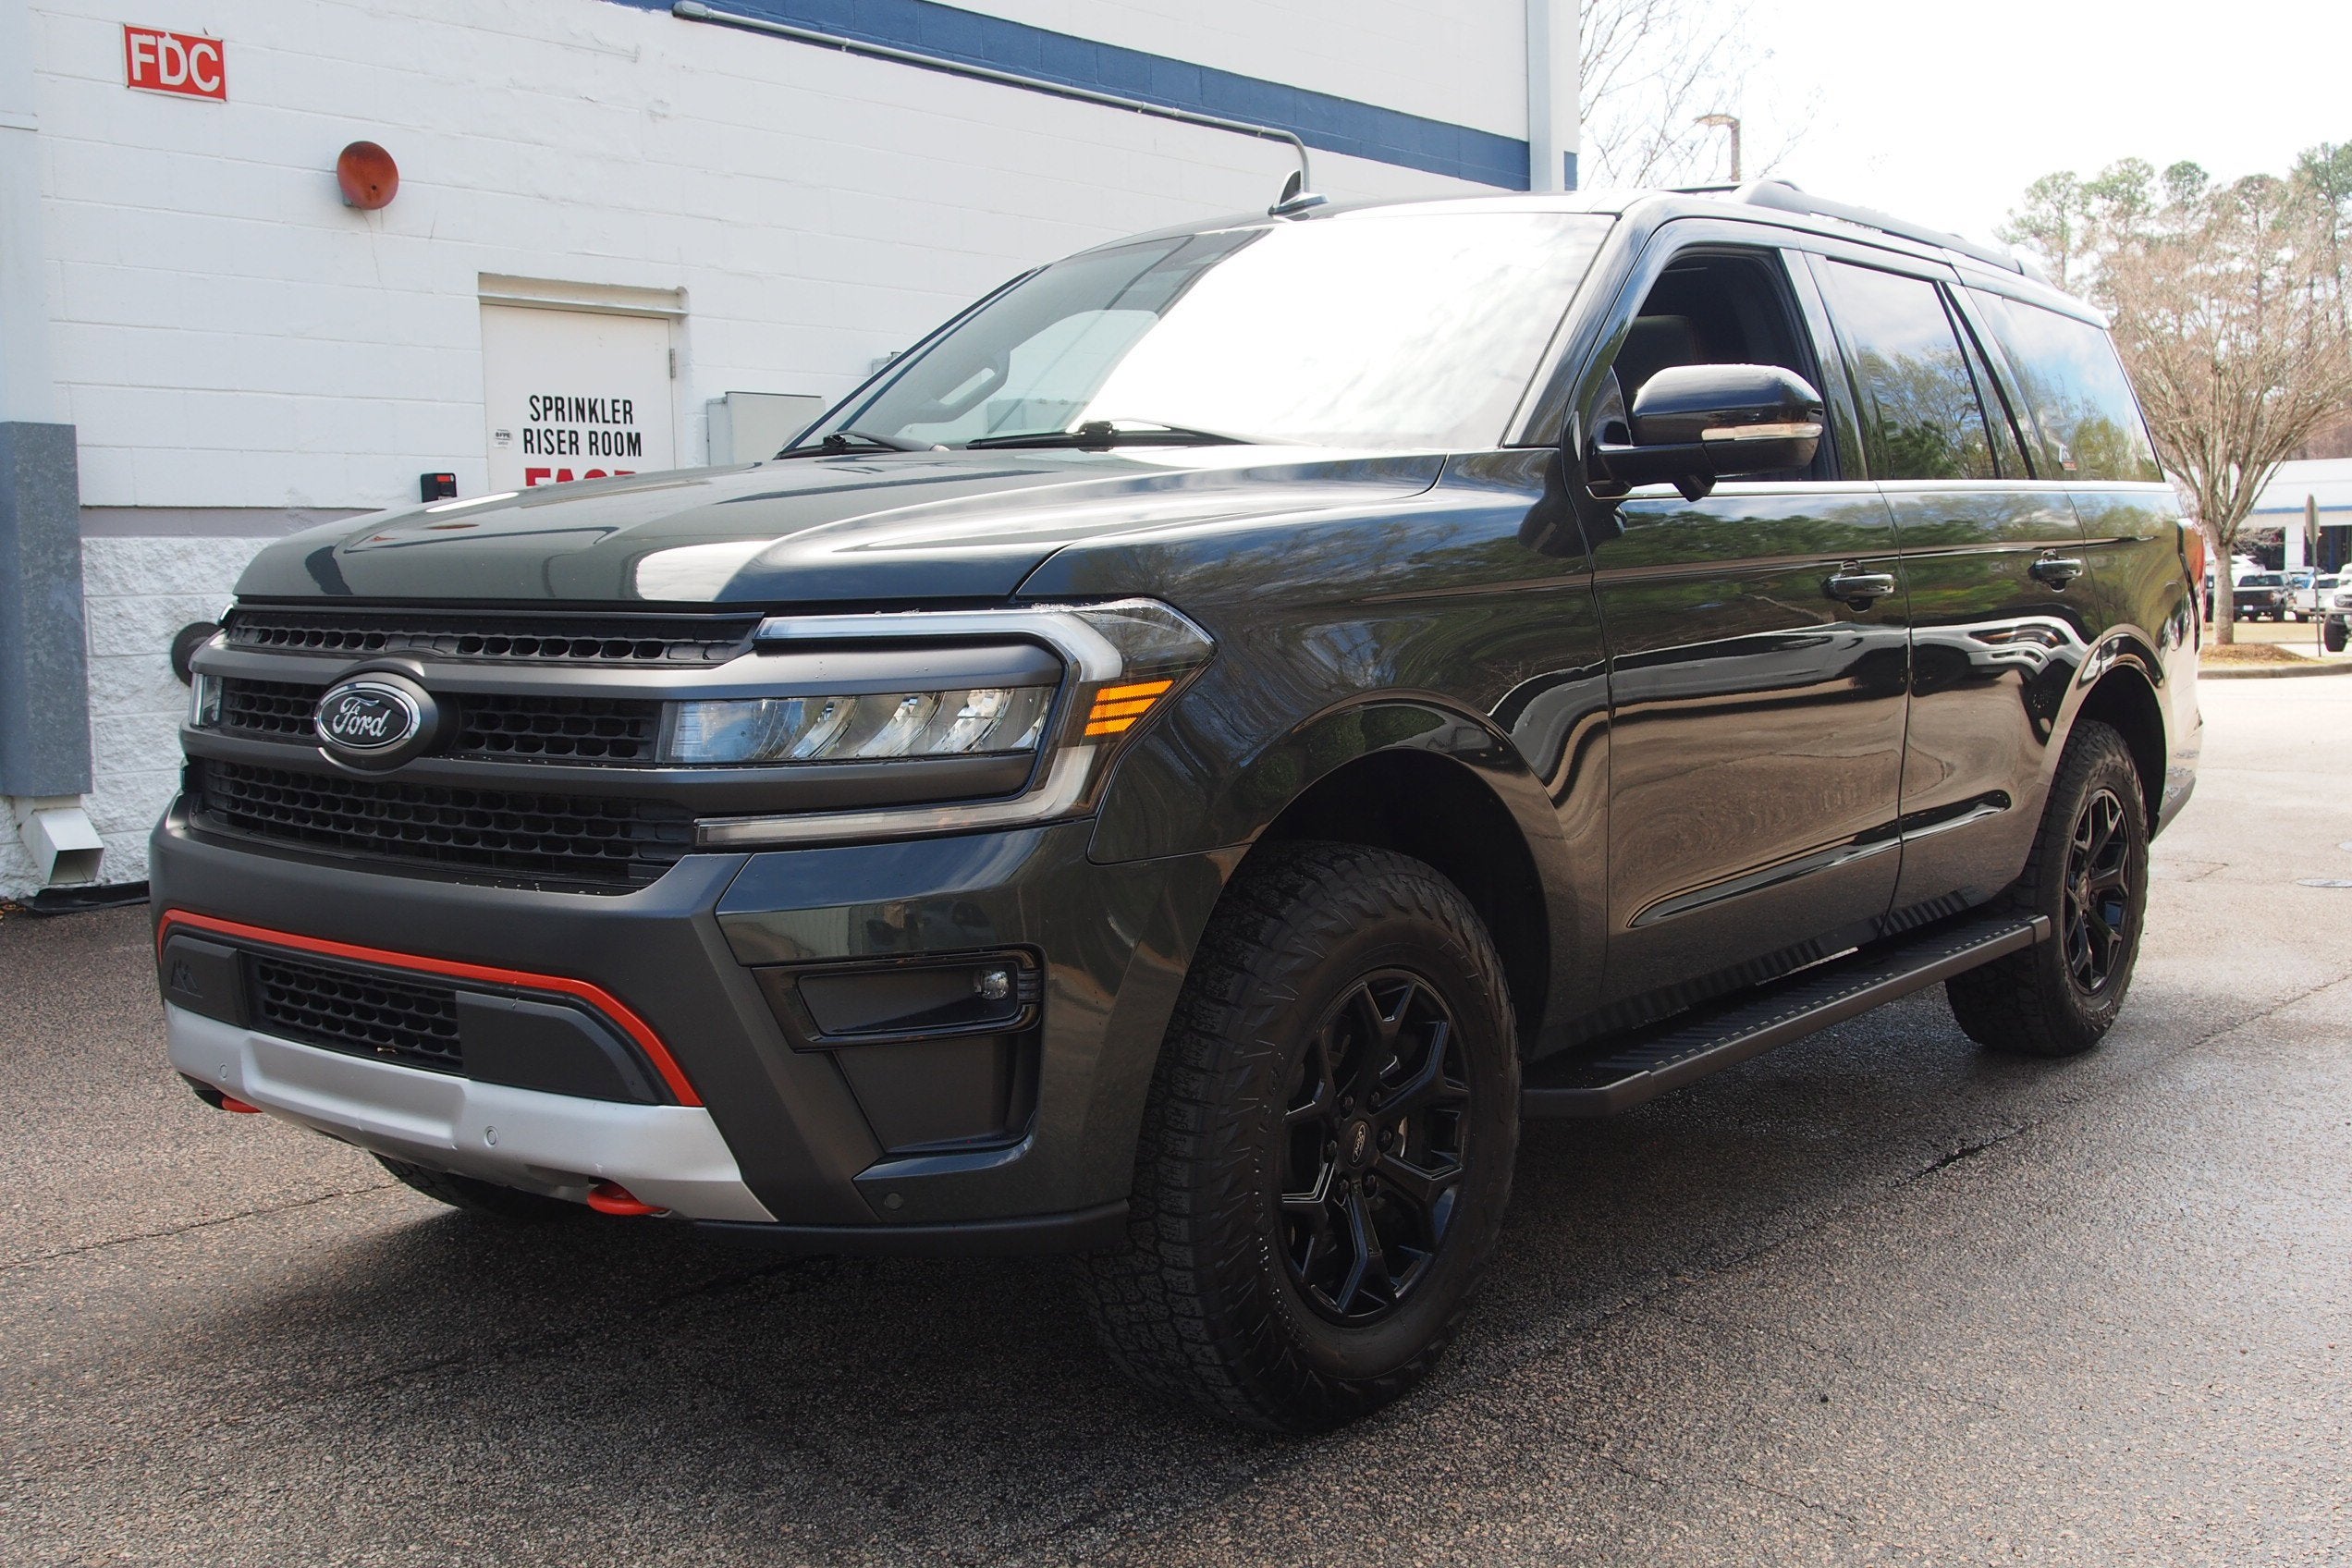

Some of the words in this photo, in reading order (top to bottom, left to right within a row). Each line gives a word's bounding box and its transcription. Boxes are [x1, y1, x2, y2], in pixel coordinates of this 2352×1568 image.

[130, 33, 220, 92] FDC
[529, 394, 633, 424] SPRINKLER
[523, 428, 580, 455] RISER
[588, 430, 642, 457] ROOM
[332, 696, 392, 737] Ford
